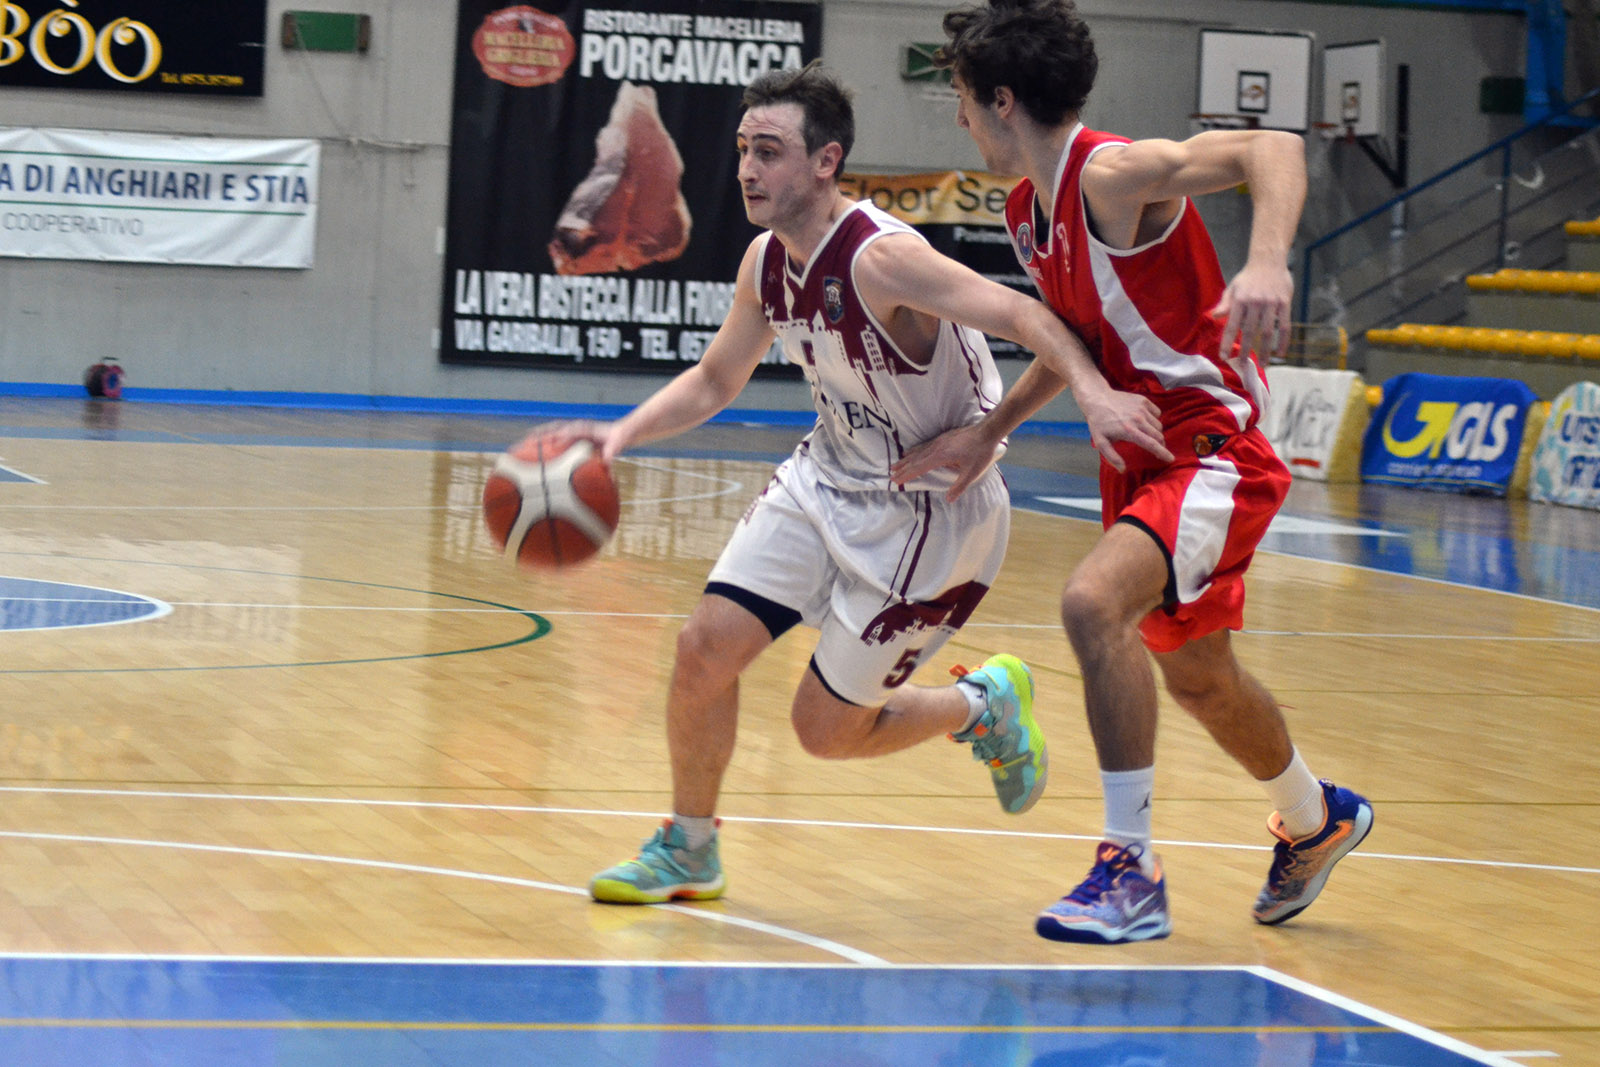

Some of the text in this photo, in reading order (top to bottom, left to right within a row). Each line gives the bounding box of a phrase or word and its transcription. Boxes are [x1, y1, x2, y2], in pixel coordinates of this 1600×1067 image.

[584, 9, 692, 36] RISTORANTE
[696, 15, 804, 43] MACELLERIA
[580, 33, 801, 86] PORCAVACCA
[25, 164, 54, 192] DI
[64, 166, 211, 200] ANGHIARI
[221, 174, 235, 200] E
[245, 176, 309, 204] STIA
[3, 212, 144, 237] COOPERATIVO
[455, 269, 482, 315] LA
[485, 270, 535, 318] VERA
[538, 273, 630, 322] BISTECCA
[632, 278, 682, 325] ALLA
[454, 319, 484, 350] VIA
[587, 327, 621, 358] 150
[639, 328, 676, 360] TEL.
[883, 648, 922, 689] 5
